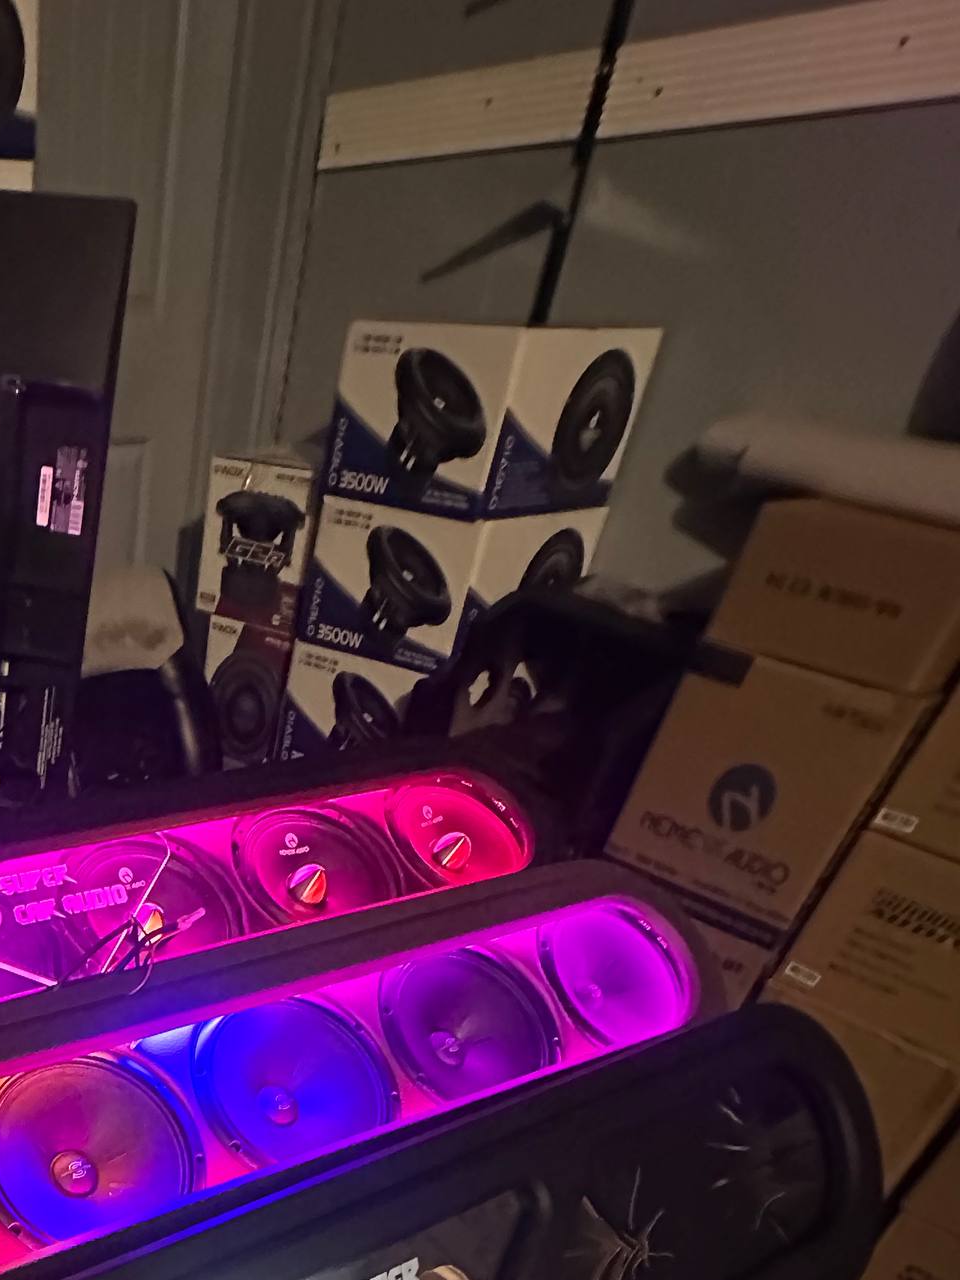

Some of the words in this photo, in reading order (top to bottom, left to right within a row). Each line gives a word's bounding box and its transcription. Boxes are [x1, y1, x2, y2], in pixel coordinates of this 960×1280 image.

[337, 469, 389, 495] 3500W
[316, 623, 364, 649] 3500W
[61, 884, 129, 914] AUDIO
